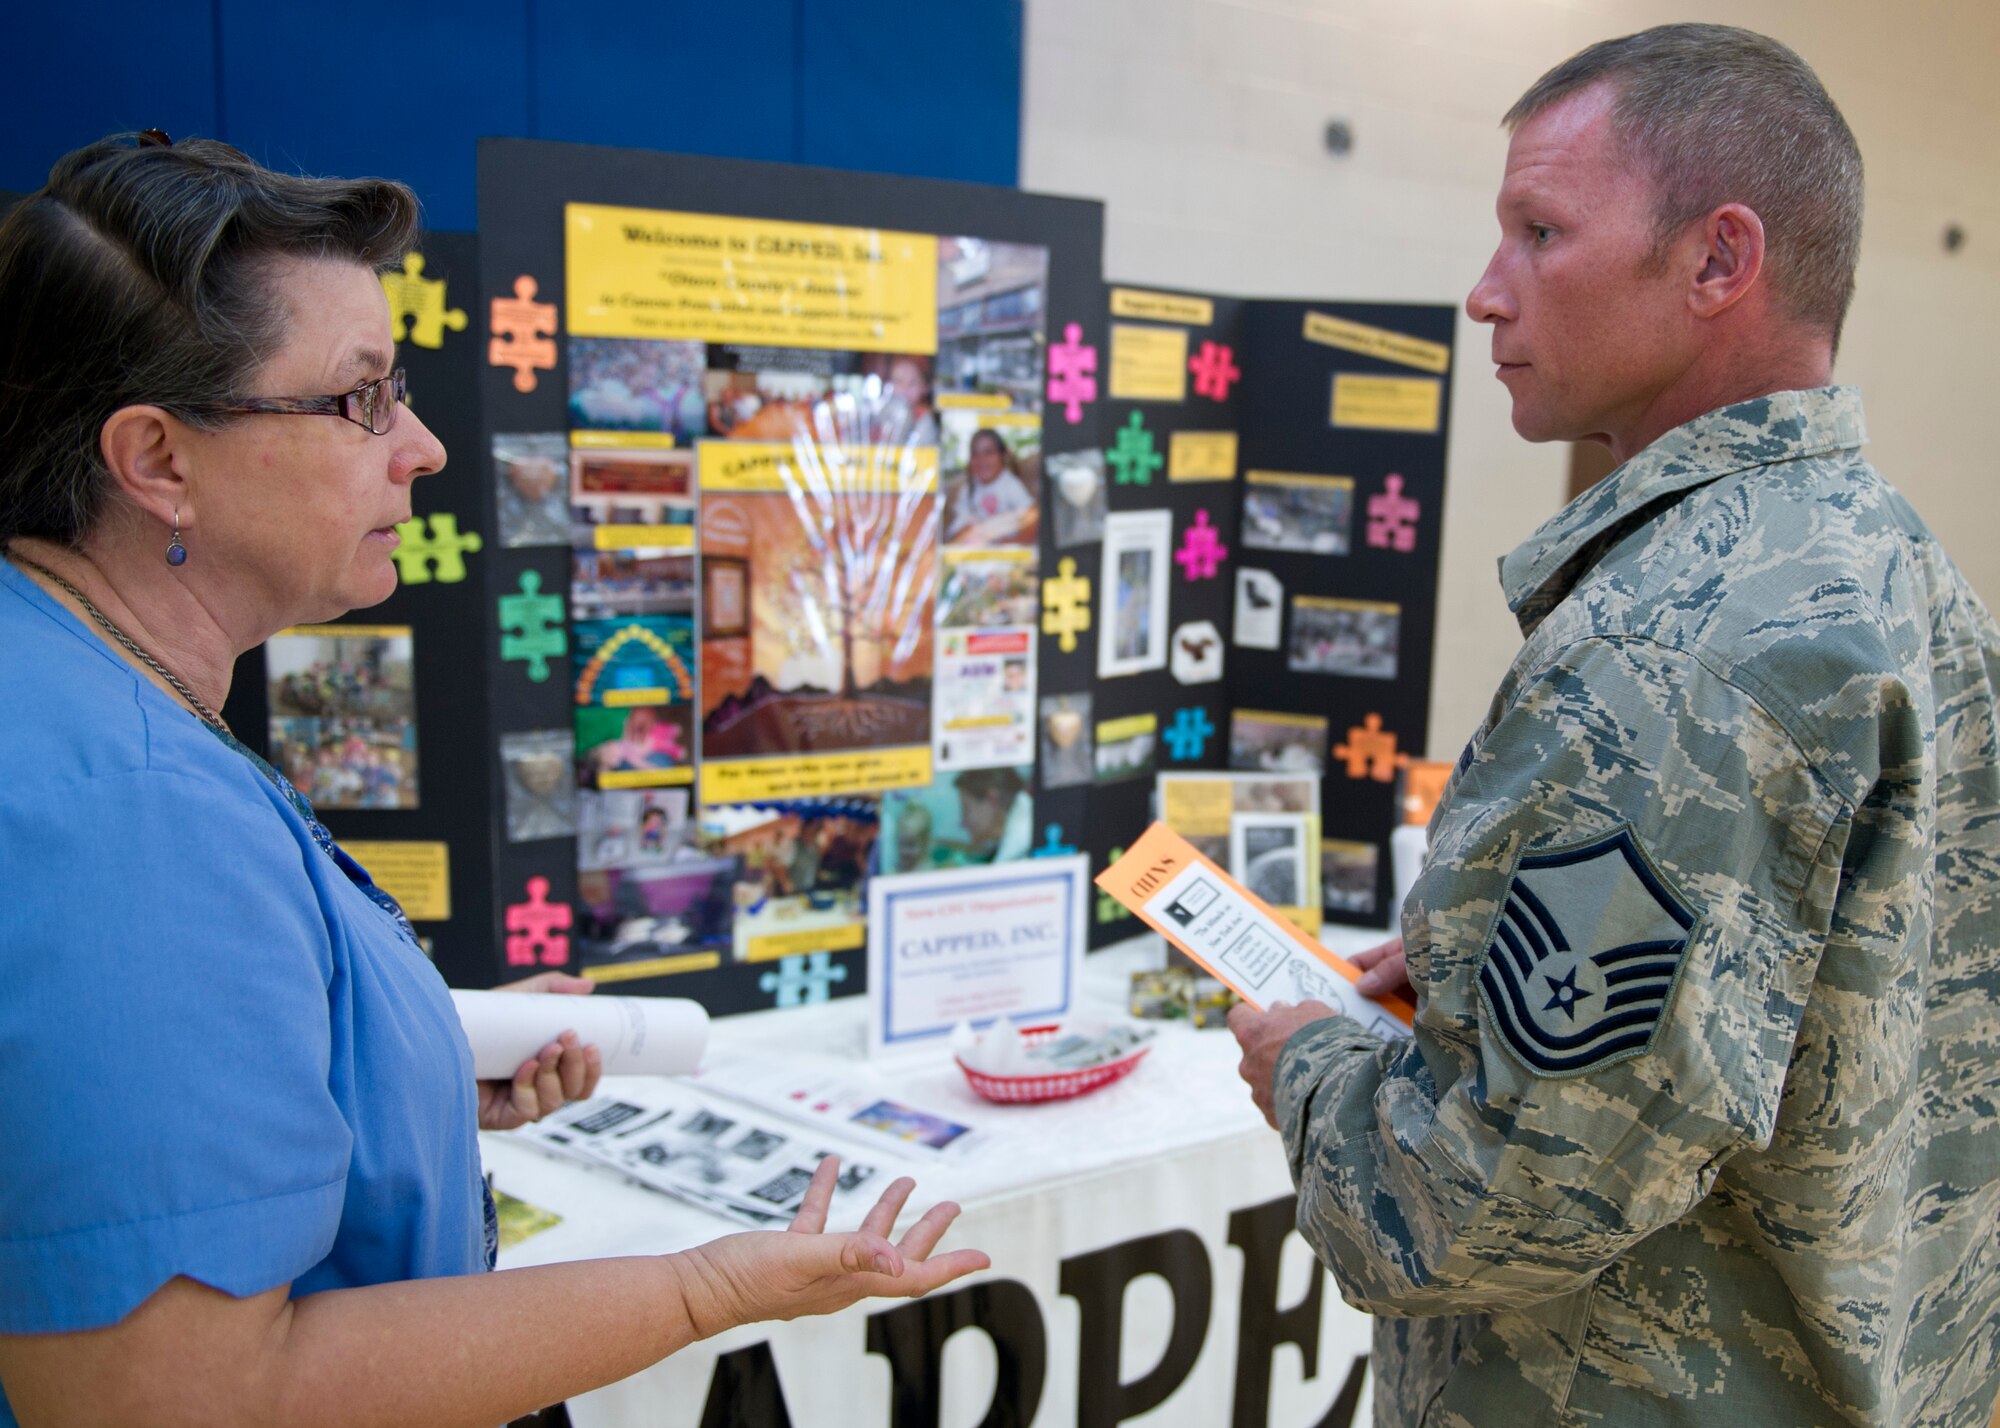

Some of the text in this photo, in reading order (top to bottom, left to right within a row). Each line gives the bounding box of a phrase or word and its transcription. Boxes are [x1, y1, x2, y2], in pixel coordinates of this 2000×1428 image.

[621, 224, 721, 248] Welcome
[900, 920, 1059, 960] CAPPED, INC.
